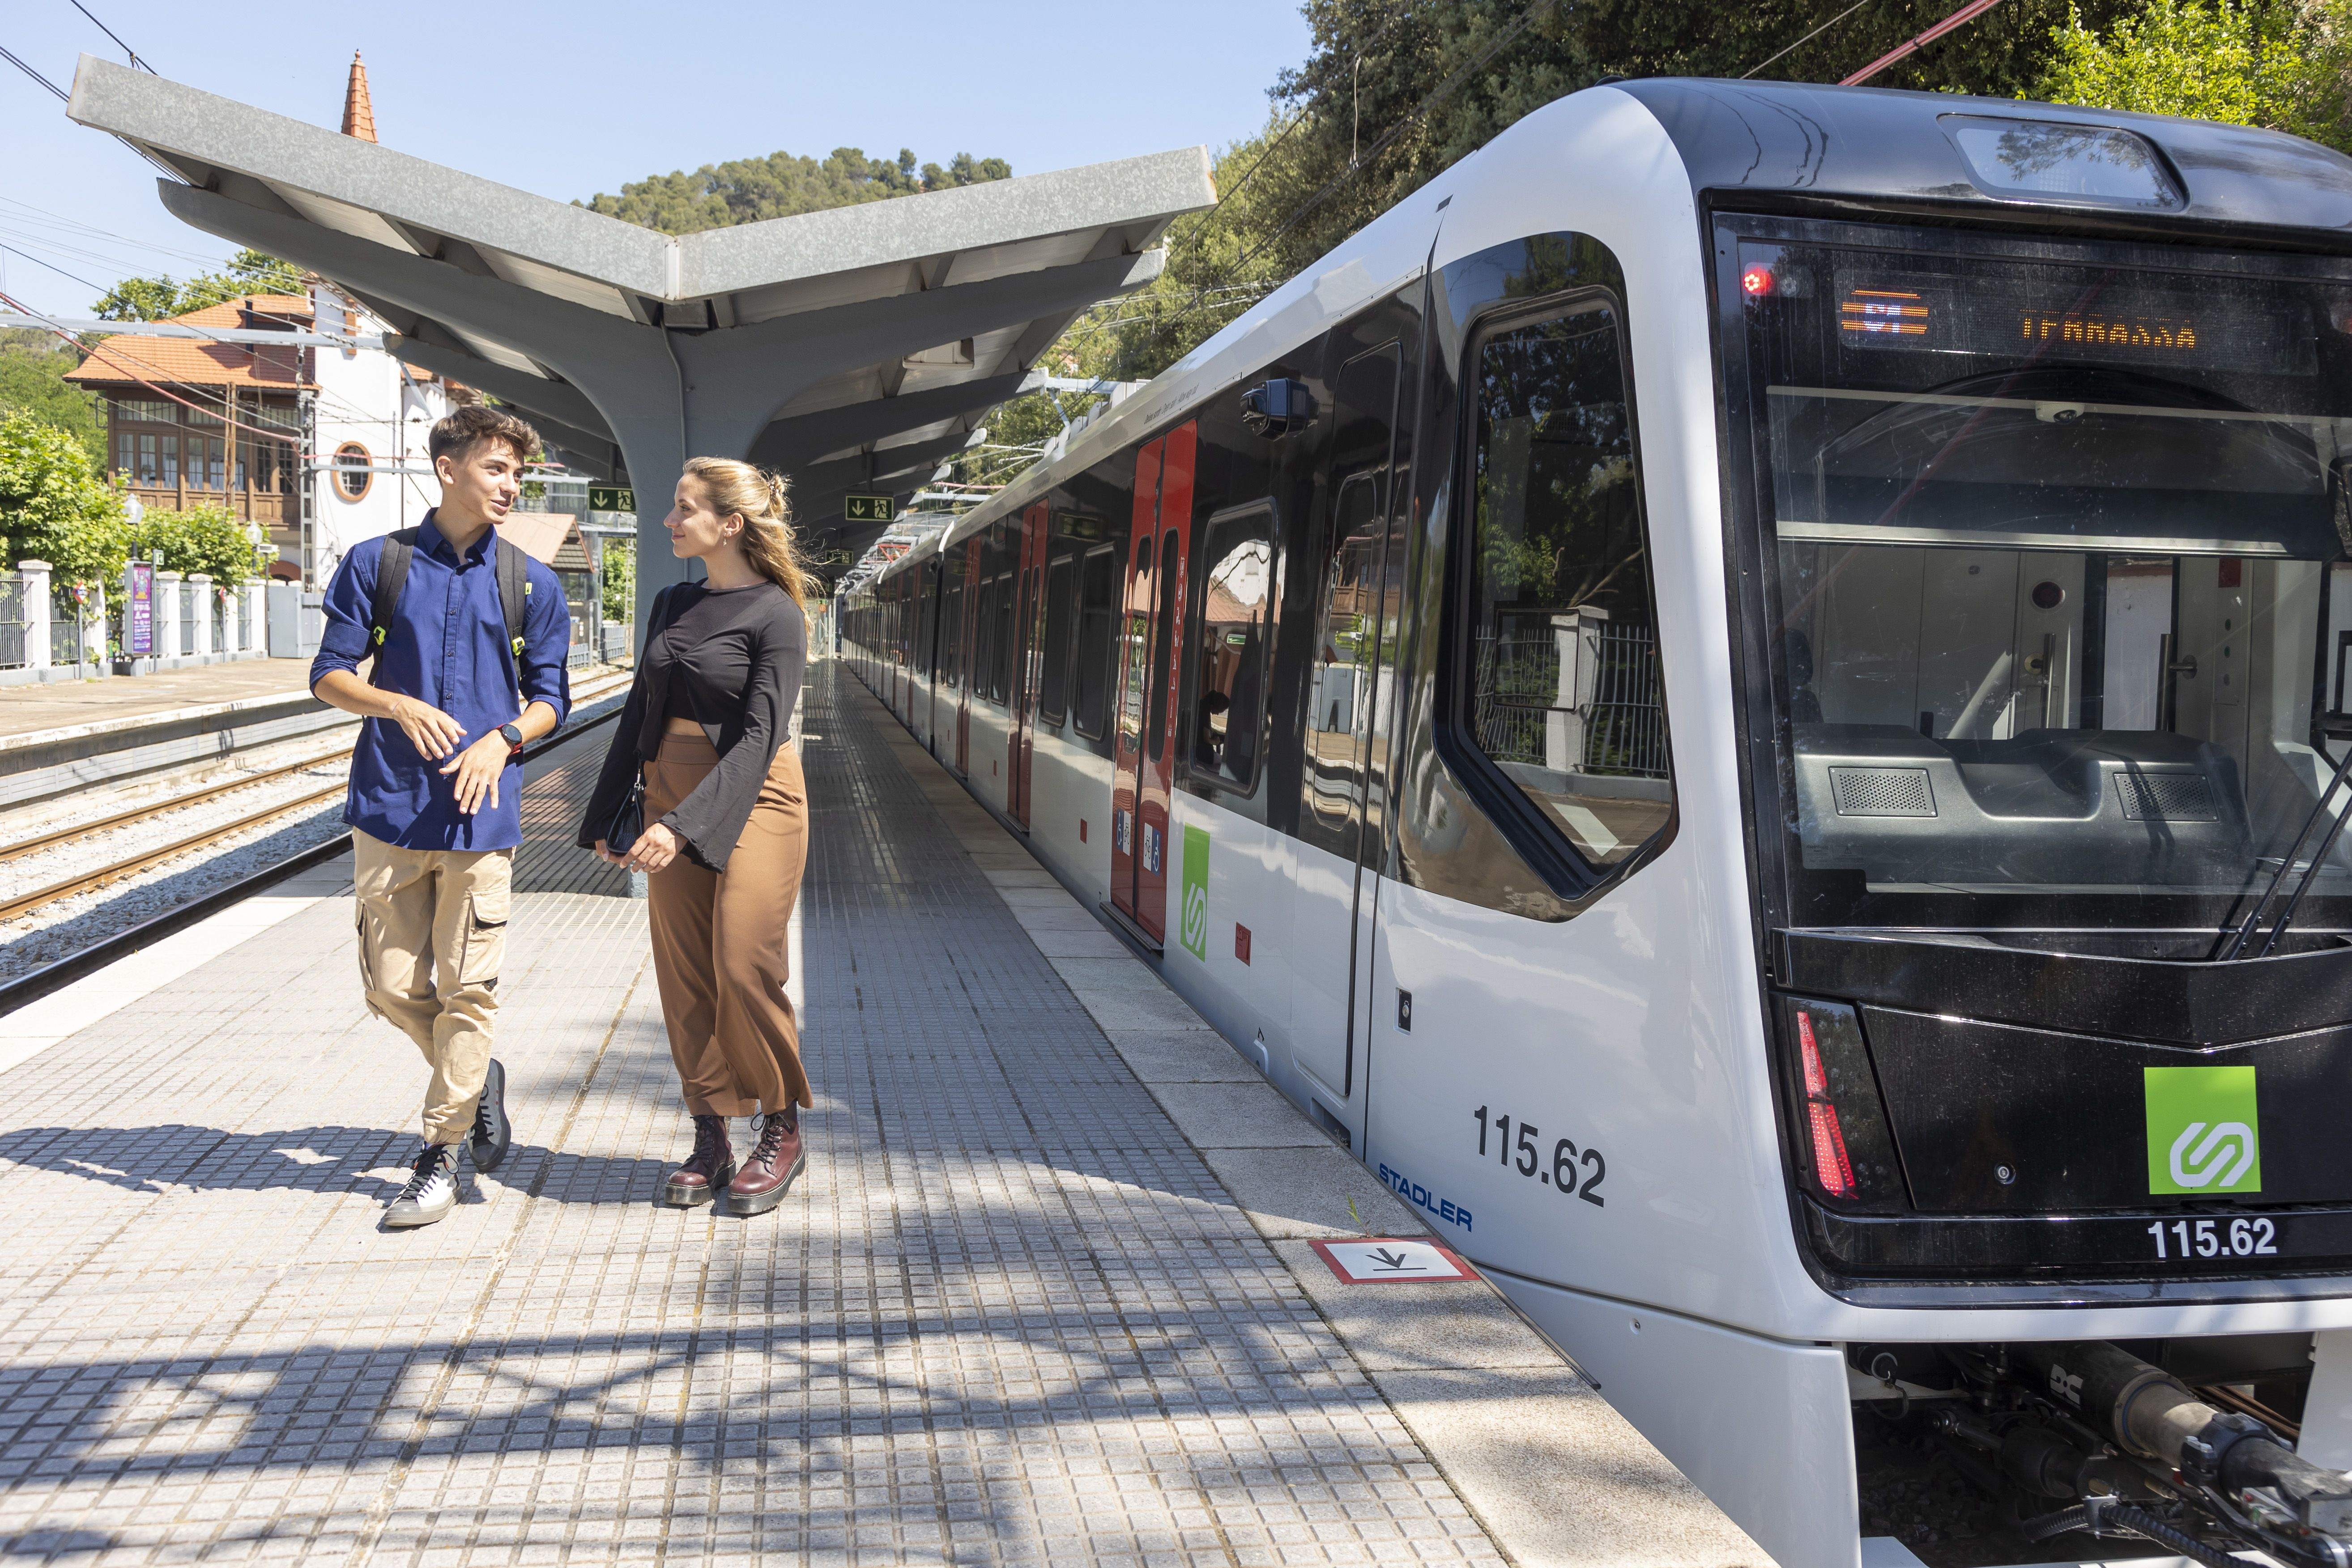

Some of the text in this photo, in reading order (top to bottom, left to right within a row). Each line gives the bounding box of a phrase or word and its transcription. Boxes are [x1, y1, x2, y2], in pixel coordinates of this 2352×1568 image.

[1474, 1104, 1606, 1208] 115.62
[1379, 1162, 1473, 1233] STADLER
[2147, 1218, 2277, 1257] 115.62
